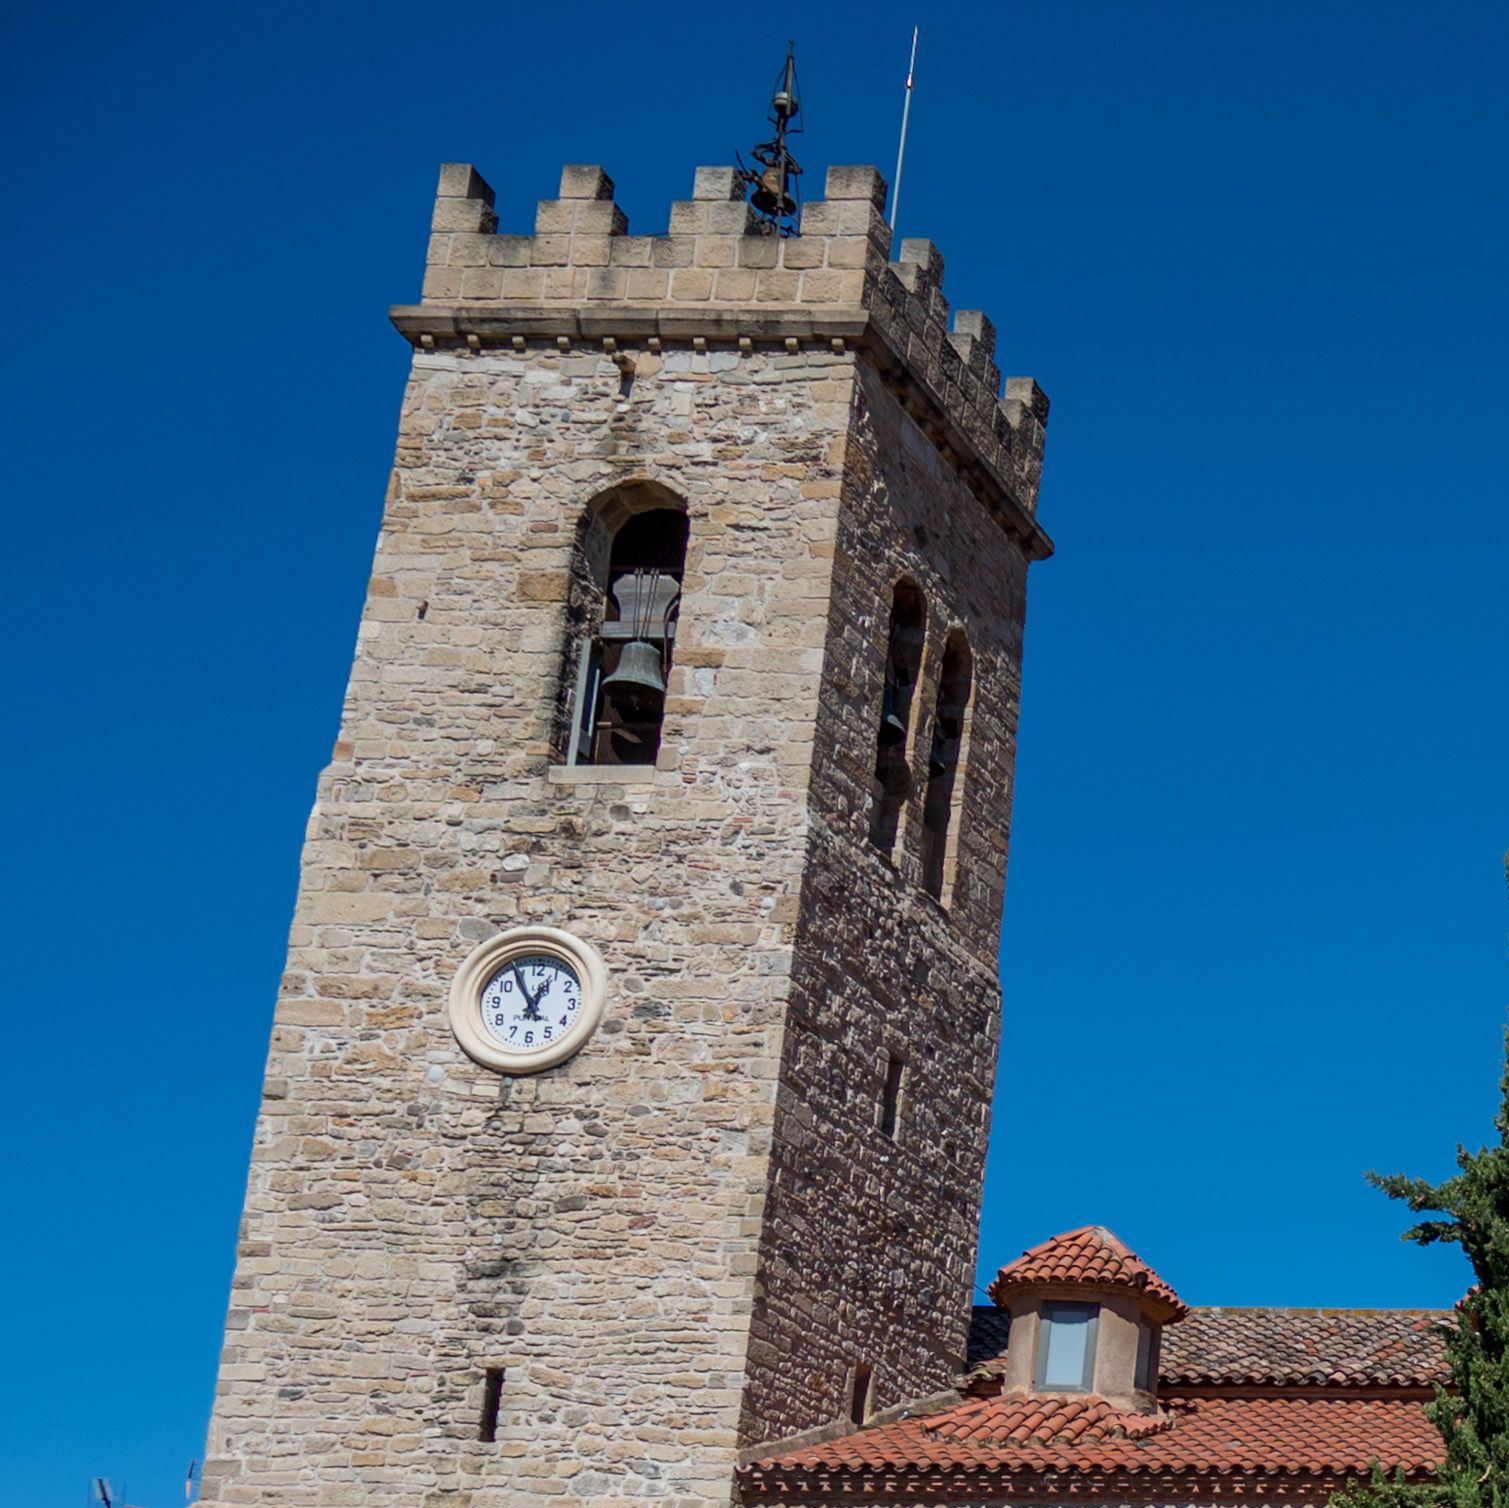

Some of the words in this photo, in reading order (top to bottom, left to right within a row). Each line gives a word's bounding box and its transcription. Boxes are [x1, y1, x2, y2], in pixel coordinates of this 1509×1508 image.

[532, 963, 546, 977] 12
[500, 980, 513, 993] 10
[563, 980, 573, 993] 2
[491, 996, 501, 1009] 9
[567, 997, 576, 1011] 3
[495, 1013, 504, 1026] 8
[559, 1014, 568, 1027] 4
[509, 1025, 518, 1038] 7
[524, 1030, 534, 1044] 6
[543, 1026, 553, 1039] 5
